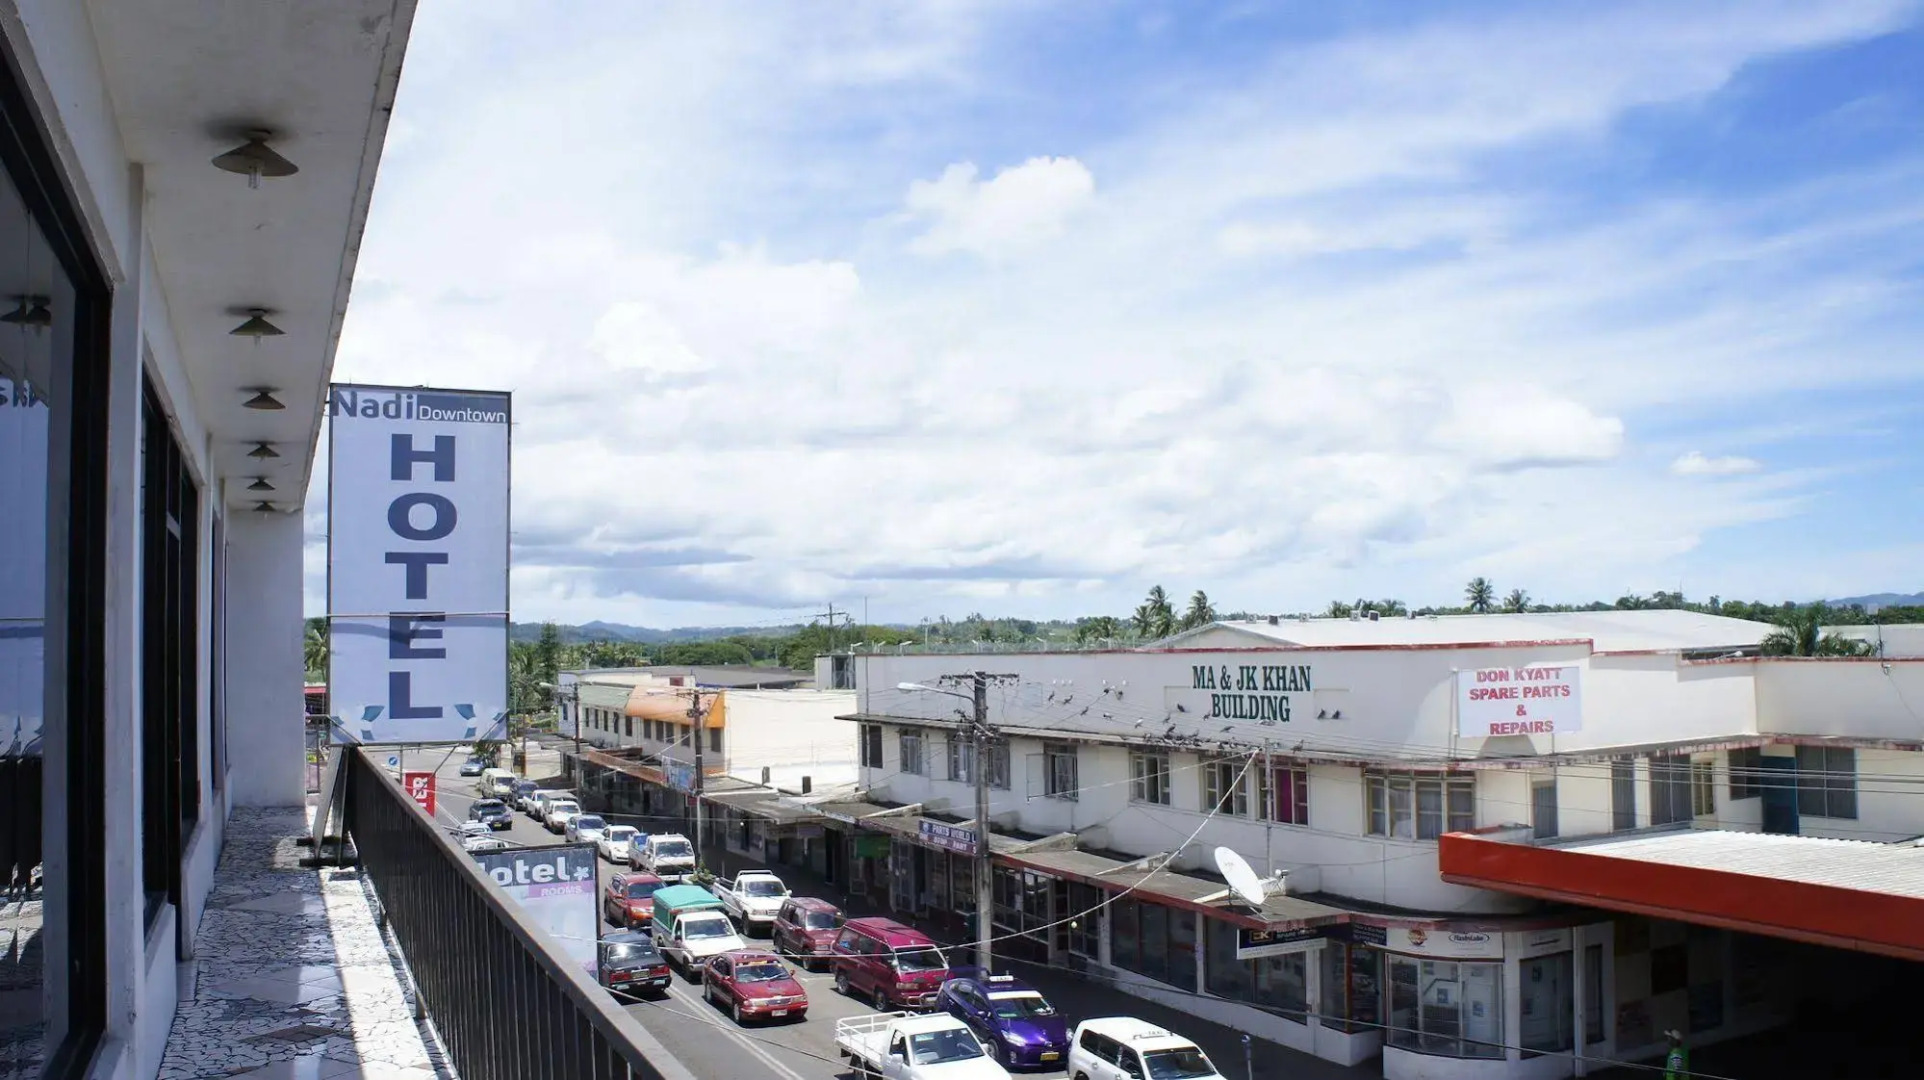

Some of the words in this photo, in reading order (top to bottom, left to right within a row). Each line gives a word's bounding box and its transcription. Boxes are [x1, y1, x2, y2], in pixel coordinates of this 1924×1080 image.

[333, 390, 413, 420] Nadi
[419, 405, 507, 423] Downtown
[384, 433, 458, 720] HOTEL
[1192, 665, 1216, 689] MA
[1220, 664, 1232, 691] &
[1237, 665, 1258, 691] JK
[1263, 665, 1311, 691] KHAN
[1476, 669, 1509, 682] DON
[1514, 667, 1562, 681] KYATT
[1470, 687, 1518, 700] SPARE
[1523, 685, 1571, 698] PARTS
[1211, 693, 1291, 722] BUILDING
[1516, 704, 1527, 716] &
[1490, 721, 1554, 735] REPAIRS
[541, 885, 583, 897] ROOMS
